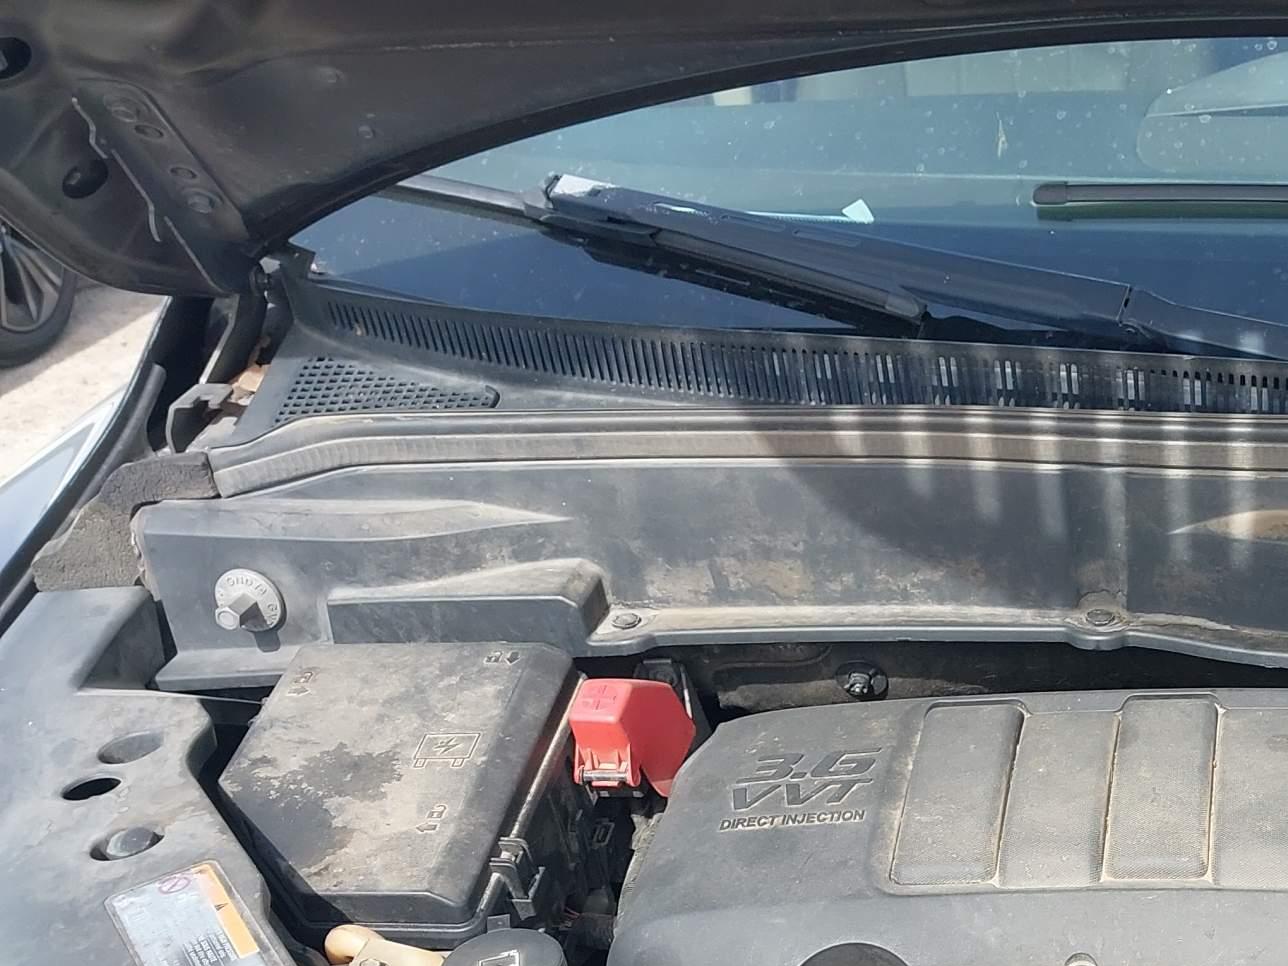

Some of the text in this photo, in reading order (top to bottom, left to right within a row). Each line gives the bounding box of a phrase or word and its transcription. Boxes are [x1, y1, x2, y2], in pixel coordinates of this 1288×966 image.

[736, 747, 882, 784] 3.6
[733, 778, 873, 811] VVT
[719, 809, 865, 831] DIRECT INJECTION
